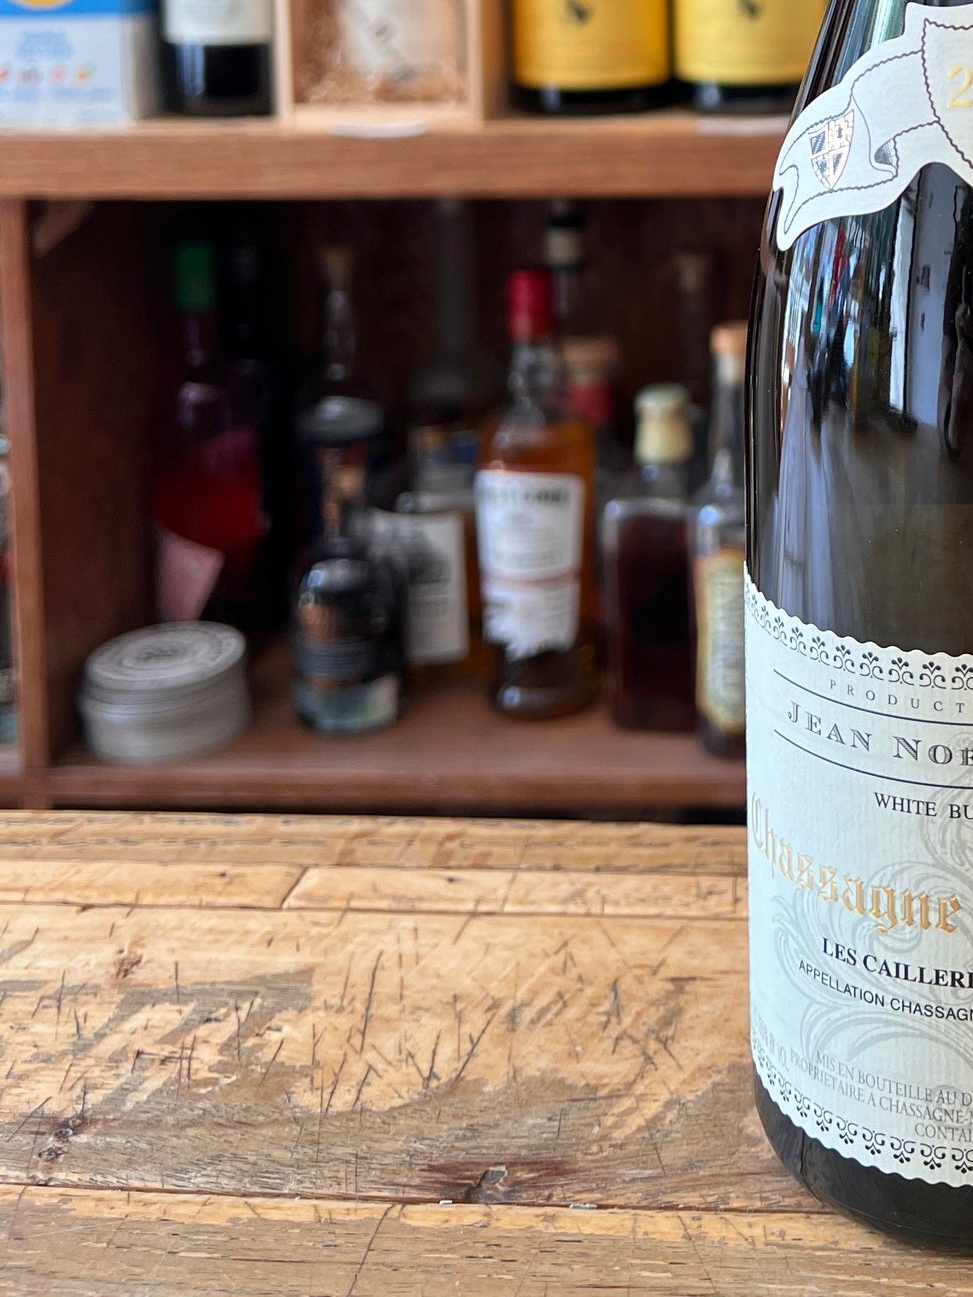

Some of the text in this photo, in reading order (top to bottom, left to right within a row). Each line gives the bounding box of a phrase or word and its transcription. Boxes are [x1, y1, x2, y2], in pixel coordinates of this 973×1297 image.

[829, 678, 966, 714] PRODUCT
[787, 700, 873, 751] JEAN
[874, 791, 938, 818] WHITE
[751, 791, 963, 935] Chassagne
[822, 937, 858, 967] LES
[798, 959, 886, 1008] APPELLATION
[790, 1047, 865, 1103] PROPRIETAIRE
[816, 1049, 836, 1073] MIS
[838, 1062, 855, 1081] EN
[858, 1069, 933, 1103] BOUTEILLE
[936, 1089, 957, 1105] AU
